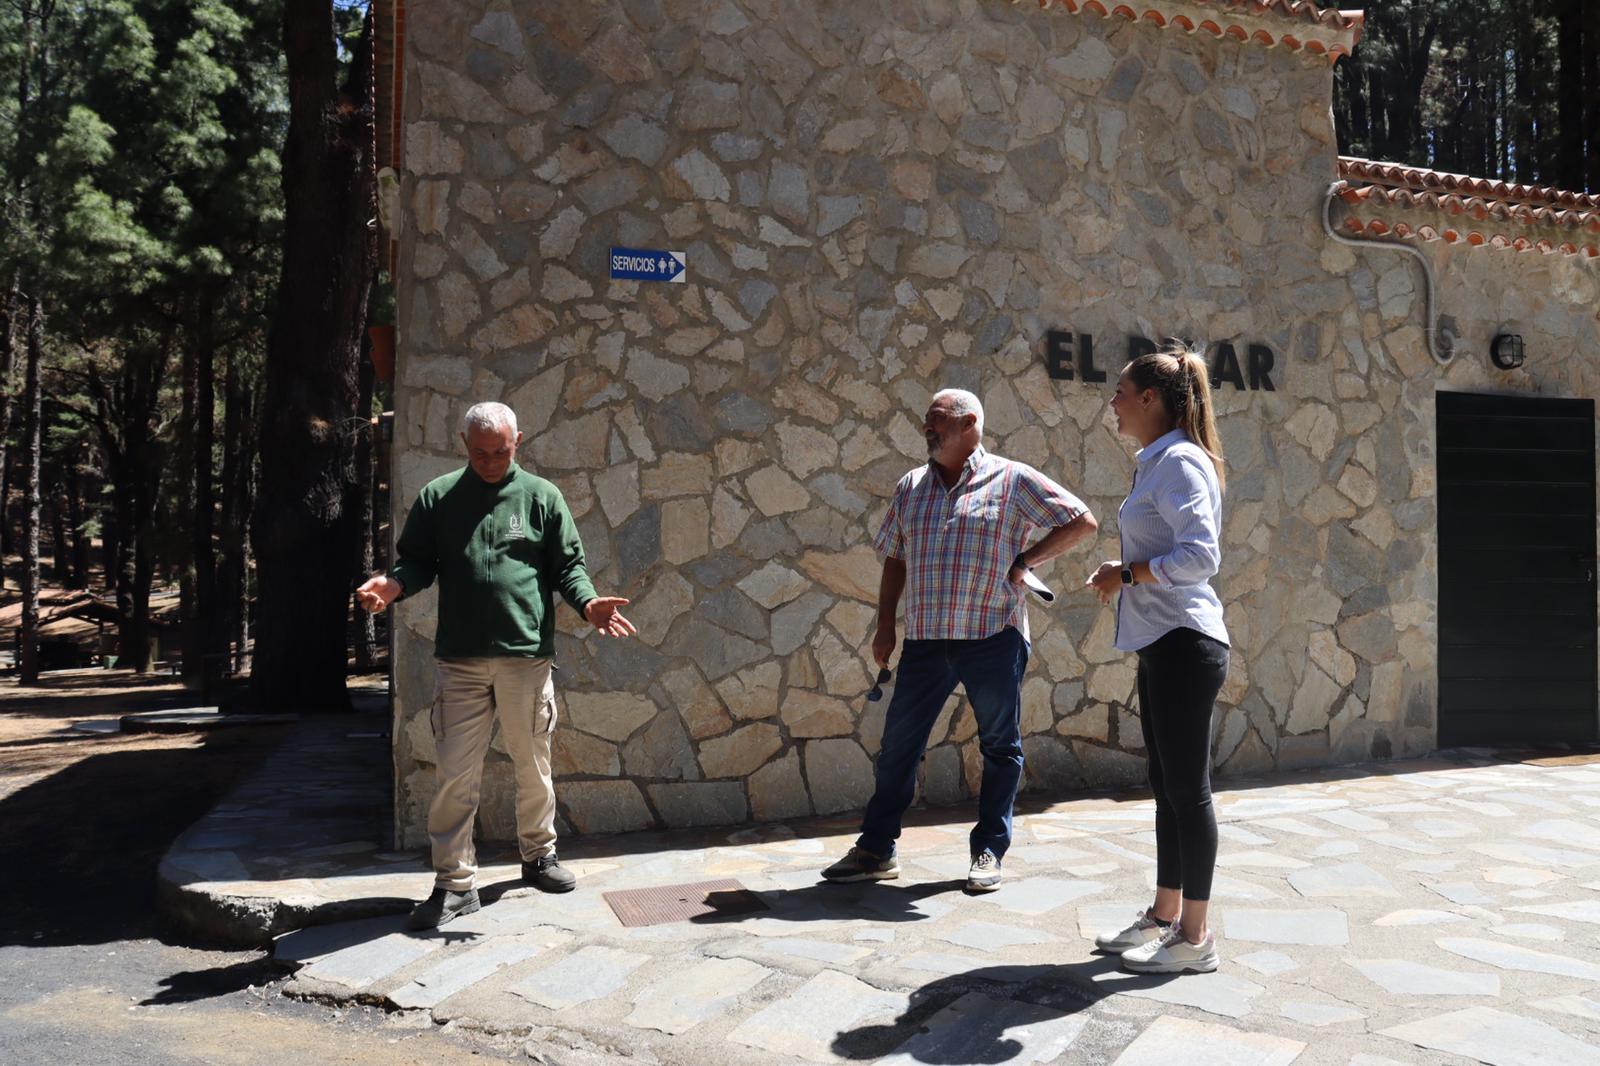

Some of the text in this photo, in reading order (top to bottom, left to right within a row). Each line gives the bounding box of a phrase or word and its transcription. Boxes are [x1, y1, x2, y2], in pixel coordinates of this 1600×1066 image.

[612, 255, 655, 272] SERVICIOS
[1048, 331, 1275, 391] EL PAR
